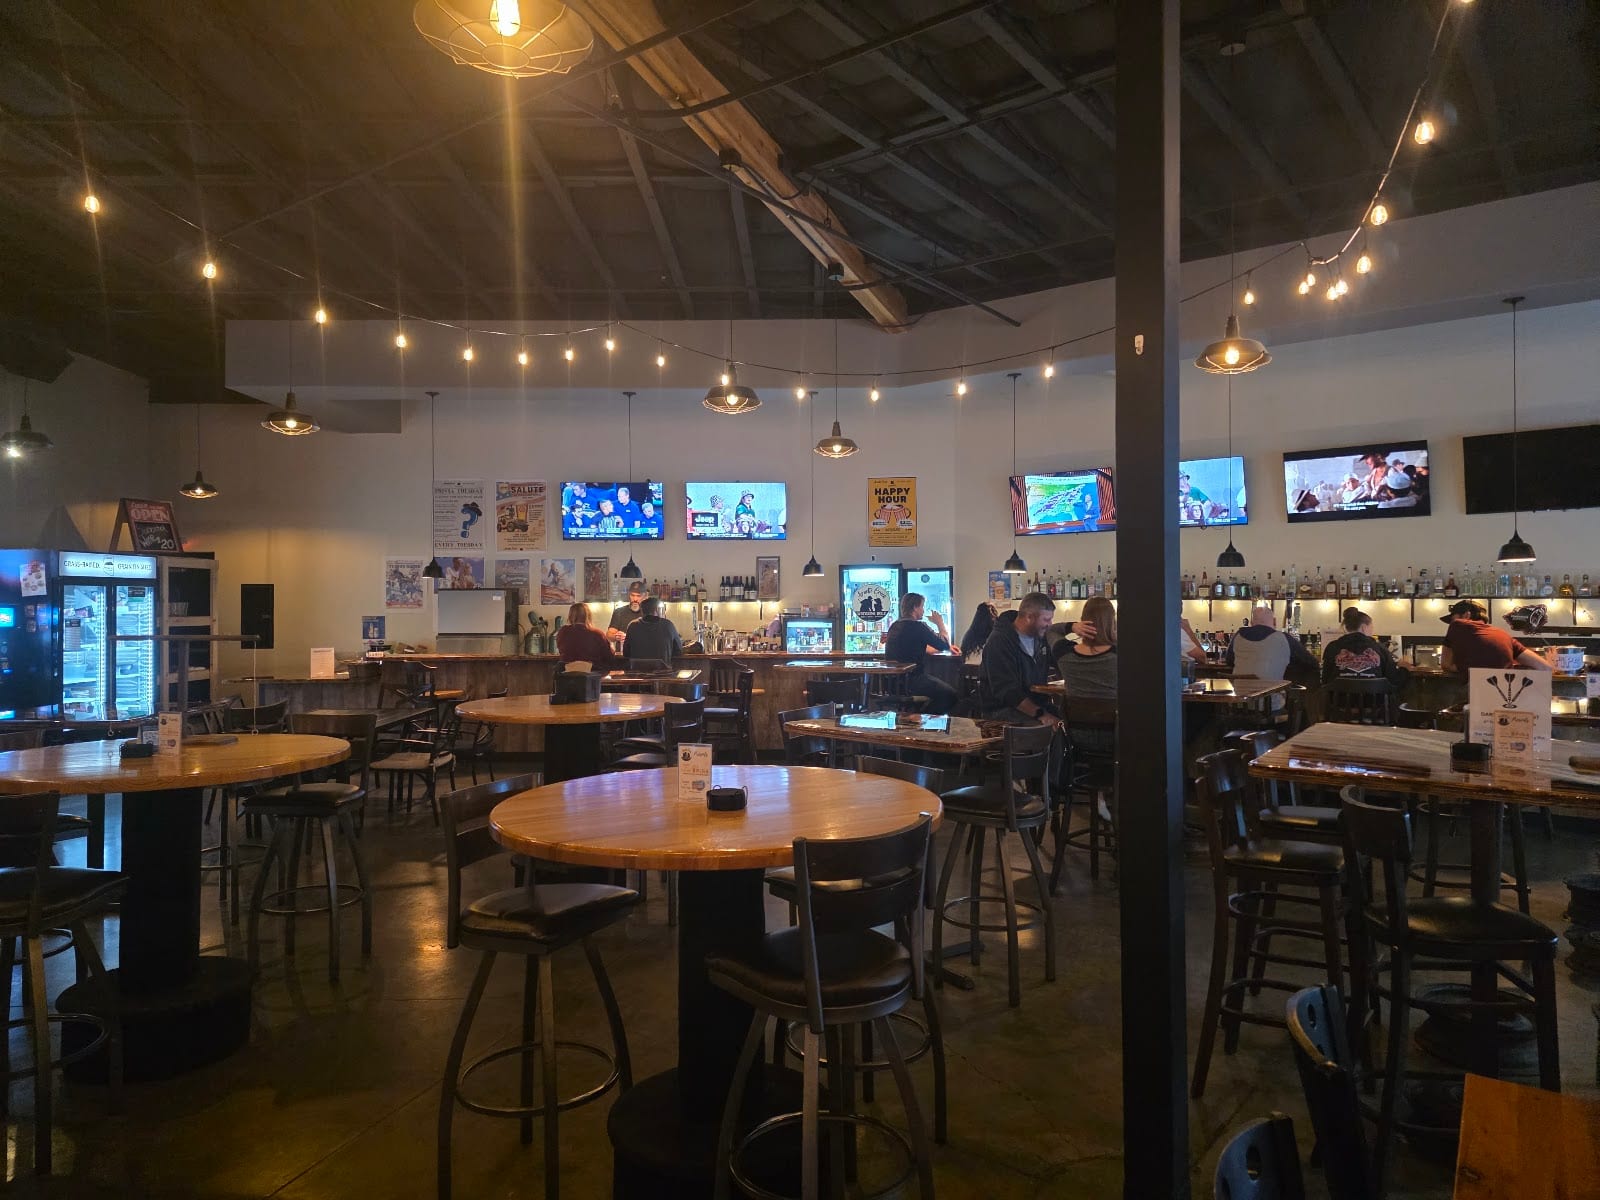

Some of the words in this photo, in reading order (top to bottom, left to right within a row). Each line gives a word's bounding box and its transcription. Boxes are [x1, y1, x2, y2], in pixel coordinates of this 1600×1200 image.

[457, 487, 483, 495] TUESDAY
[511, 486, 544, 494] SALUTE
[874, 487, 910, 496] HAPPY
[878, 495, 907, 503] HOUR
[131, 508, 170, 521] OPEN
[694, 514, 715, 524] Jeep
[161, 539, 175, 550] 20
